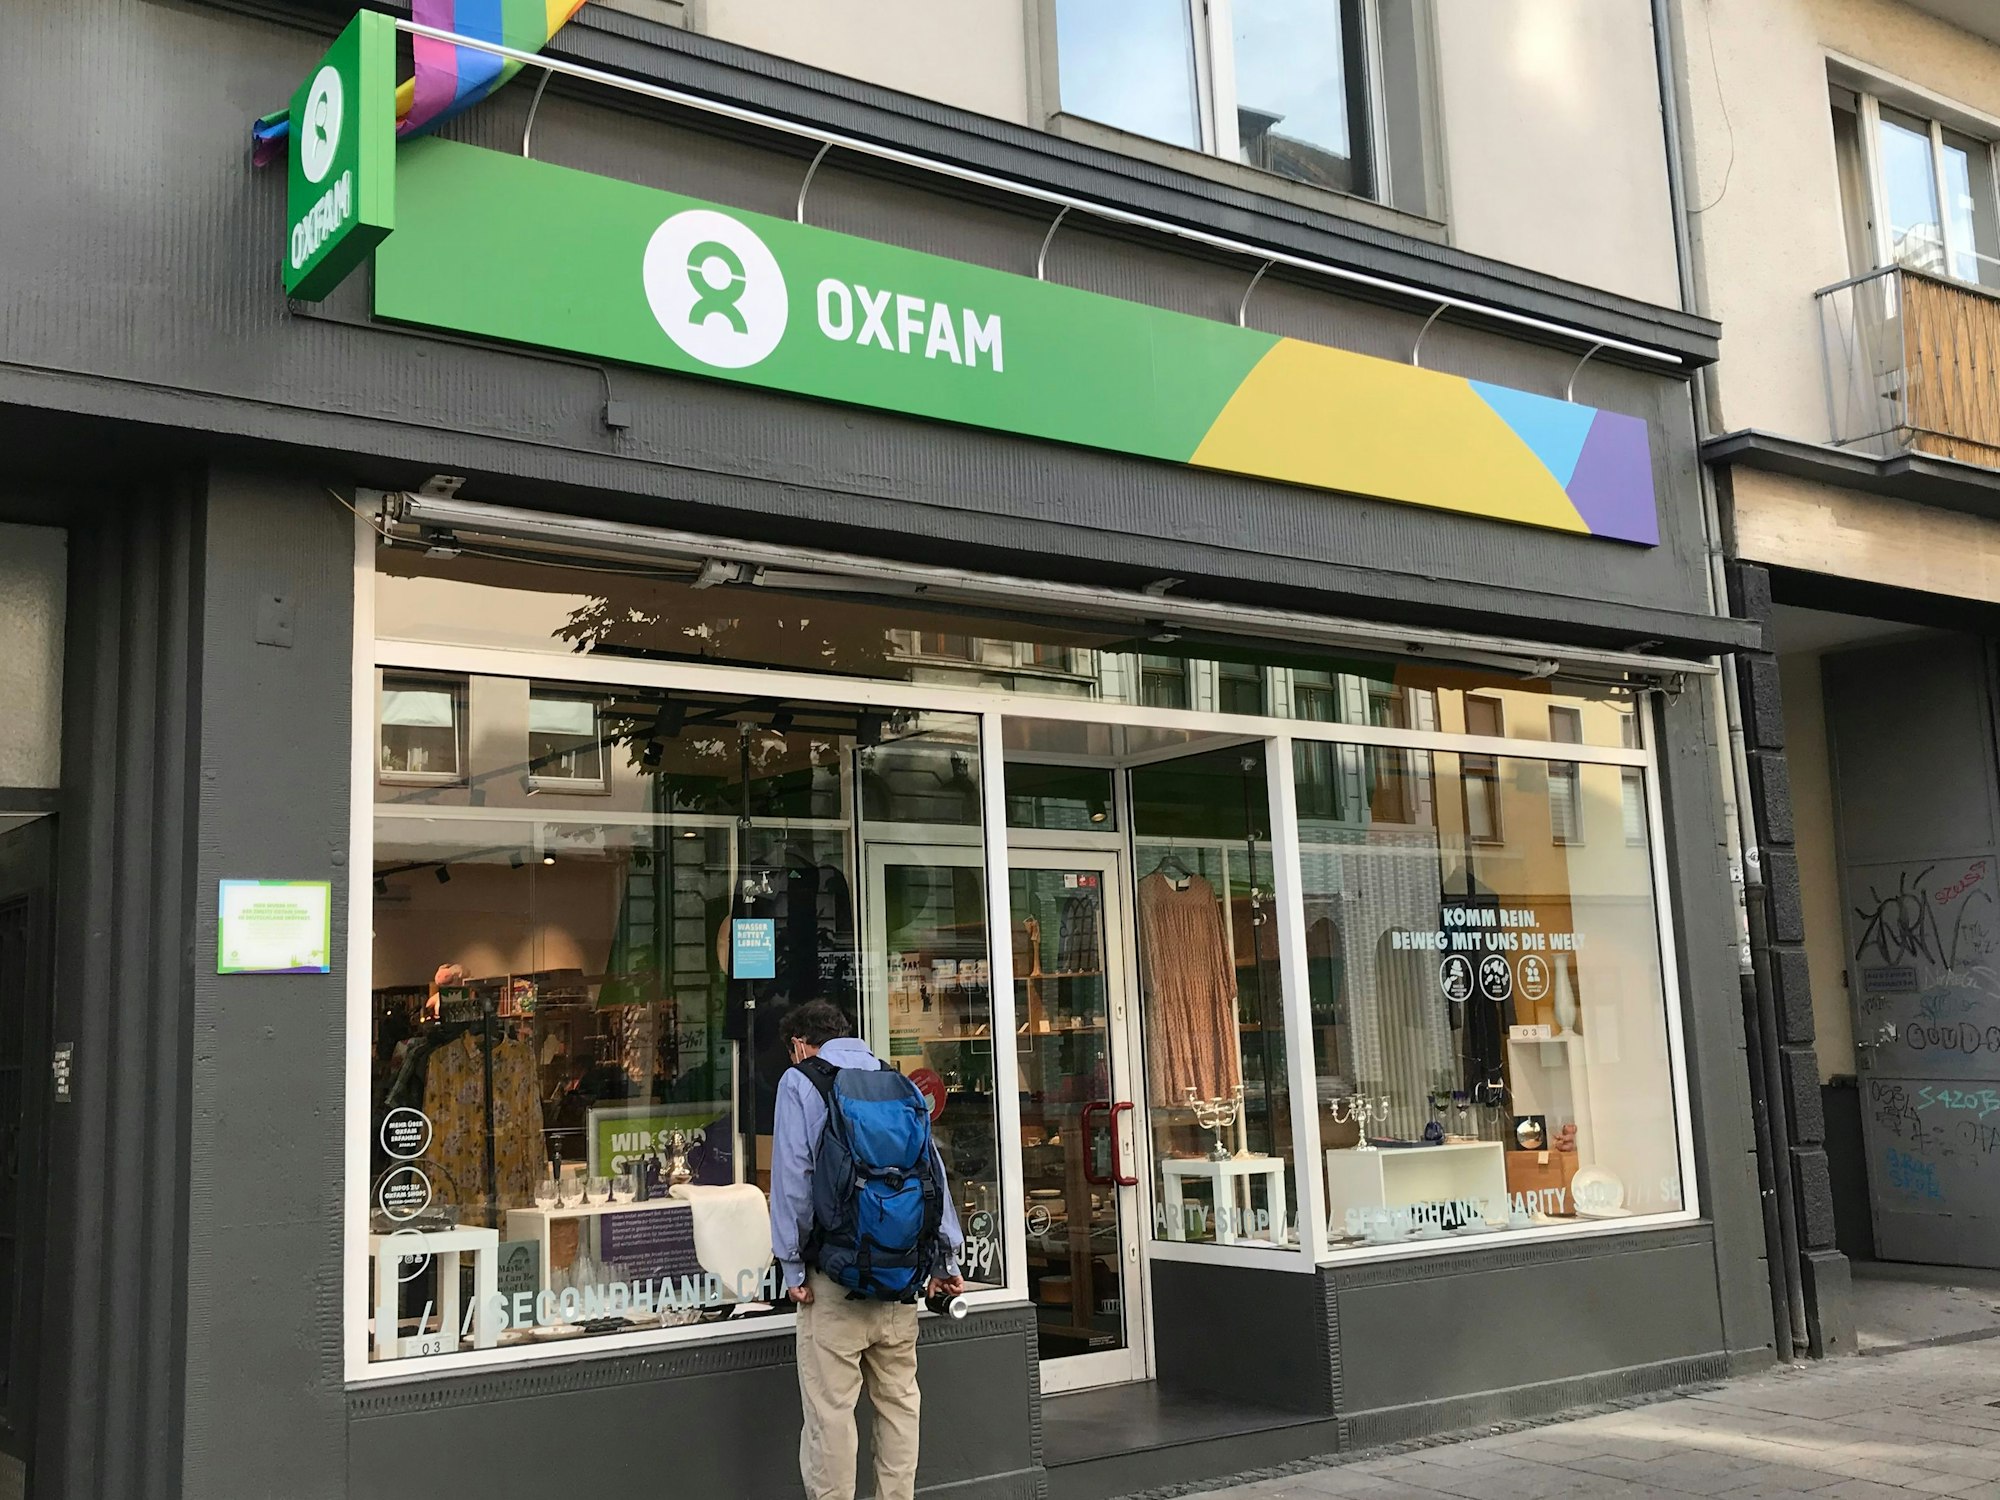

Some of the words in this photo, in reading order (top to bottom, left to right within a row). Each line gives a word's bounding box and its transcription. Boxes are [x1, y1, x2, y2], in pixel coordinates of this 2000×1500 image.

[291, 169, 351, 270] OXFAM
[816, 278, 1004, 373] OXFAM
[1443, 907, 1497, 927] KOMM
[1500, 909, 1541, 928] REIN.
[737, 923, 768, 931] WASSER
[737, 931, 765, 939] RETTET
[737, 939, 761, 948] LEBEN
[1391, 930, 1449, 950] BEWEG
[1452, 931, 1482, 950] MIT
[1485, 932, 1519, 951] UNS
[1522, 932, 1546, 950] DIE
[389, 1121, 407, 1130] MEHR
[407, 1120, 424, 1129] ÜBER
[394, 1128, 418, 1136] OXFAM
[391, 1134, 422, 1143] ERFAHREN
[391, 1184, 410, 1192] INFOS
[410, 1183, 421, 1191] ZU
[384, 1191, 407, 1200] OXFAM
[407, 1189, 427, 1199] SHOPS
[1216, 1206, 1270, 1238] SHOP
[488, 1270, 723, 1333] SECONDHAND
